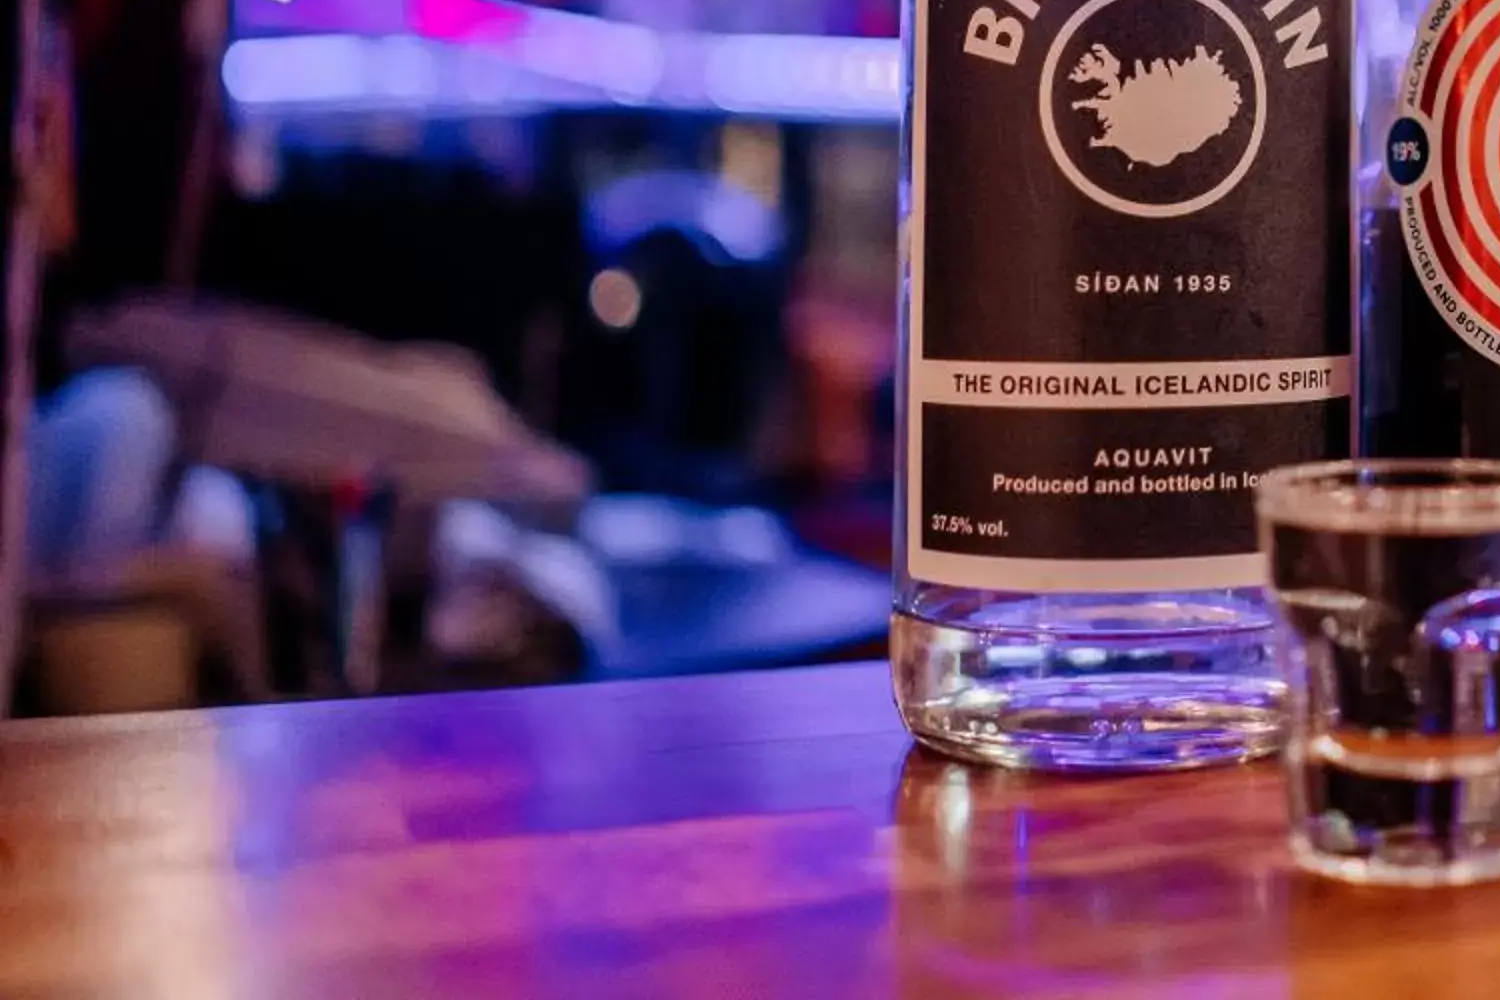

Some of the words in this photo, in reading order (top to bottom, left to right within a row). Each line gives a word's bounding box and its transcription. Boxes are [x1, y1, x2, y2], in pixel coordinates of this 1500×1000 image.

[1075, 271, 1160, 293] SÍÐAN
[1174, 275, 1231, 293] 1935
[1433, 283, 1457, 313] AND
[953, 373, 993, 393] THE
[1000, 375, 1125, 395] ORIGINAL
[1135, 373, 1271, 395] ICELANDIC
[1278, 368, 1332, 391] SPIRIT
[1094, 447, 1213, 468] AQUAVIT
[993, 473, 1089, 494] Produced
[1094, 473, 1135, 494] and
[1141, 471, 1215, 493] bottled
[1220, 472, 1237, 489] in
[931, 513, 973, 534] 37.5%
[977, 519, 1009, 537] vol.
